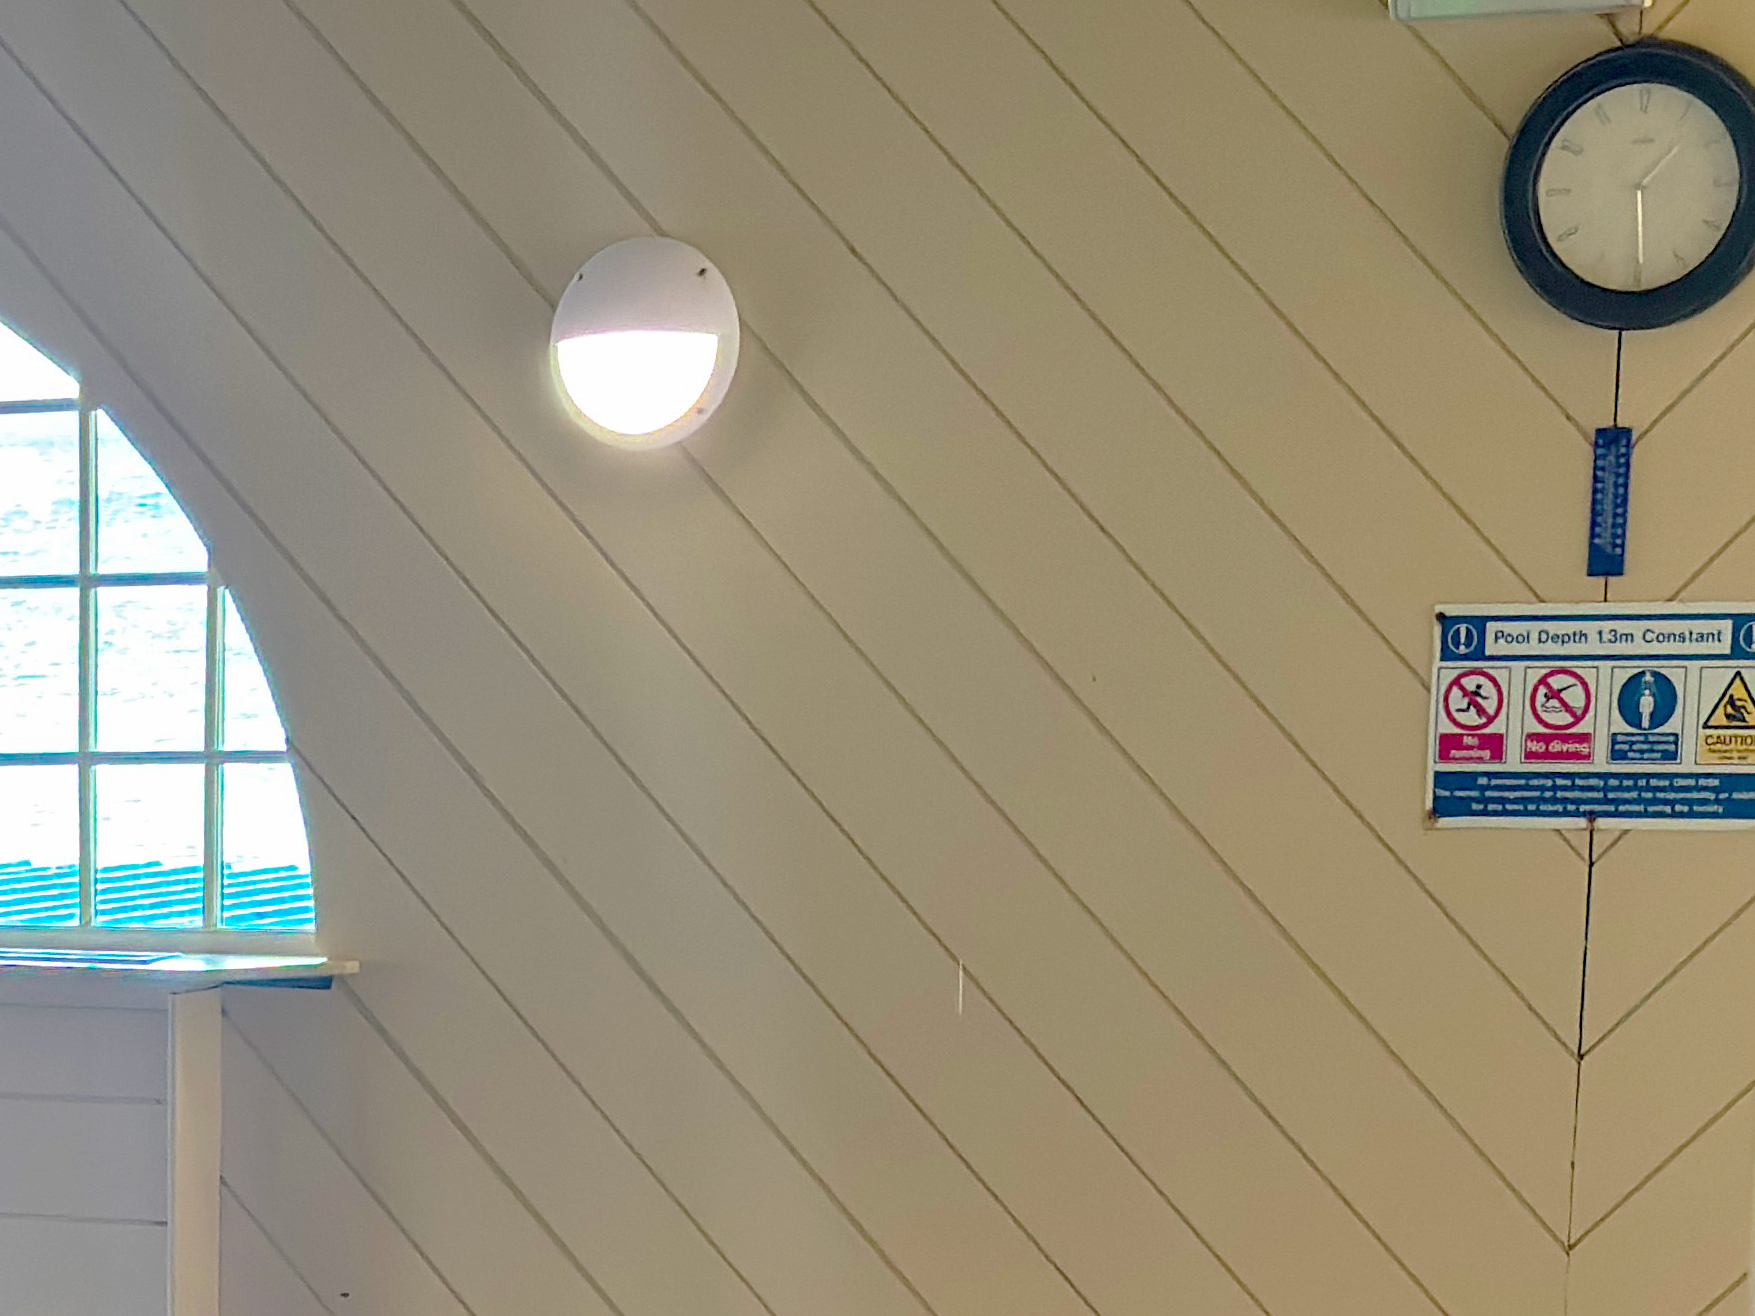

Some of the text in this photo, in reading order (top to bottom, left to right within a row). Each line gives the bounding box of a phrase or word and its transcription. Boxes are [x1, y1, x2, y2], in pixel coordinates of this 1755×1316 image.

[1493, 628, 1723, 646] Pool Depth 1.3m Constant
[1525, 738, 1590, 755] No diving
